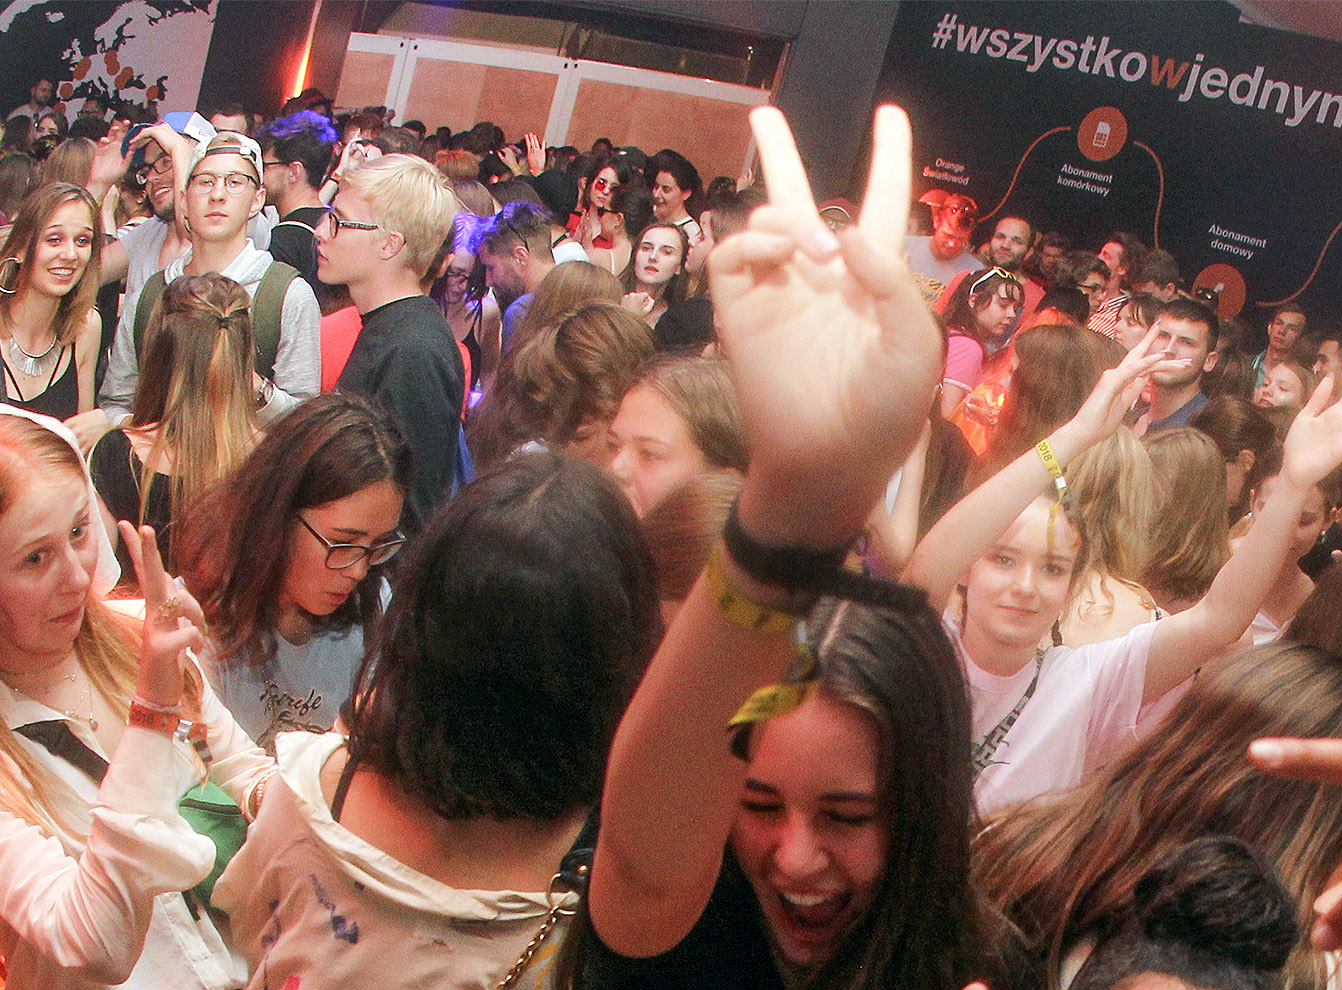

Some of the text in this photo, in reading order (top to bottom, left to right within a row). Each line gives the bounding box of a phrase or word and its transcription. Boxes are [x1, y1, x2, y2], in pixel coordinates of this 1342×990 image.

[935, 157, 966, 173] Orange
[1060, 163, 1114, 183] Abonament
[1056, 175, 1111, 197] komórkowy
[1208, 224, 1267, 248] Abonament
[1210, 239, 1254, 260] domowy
